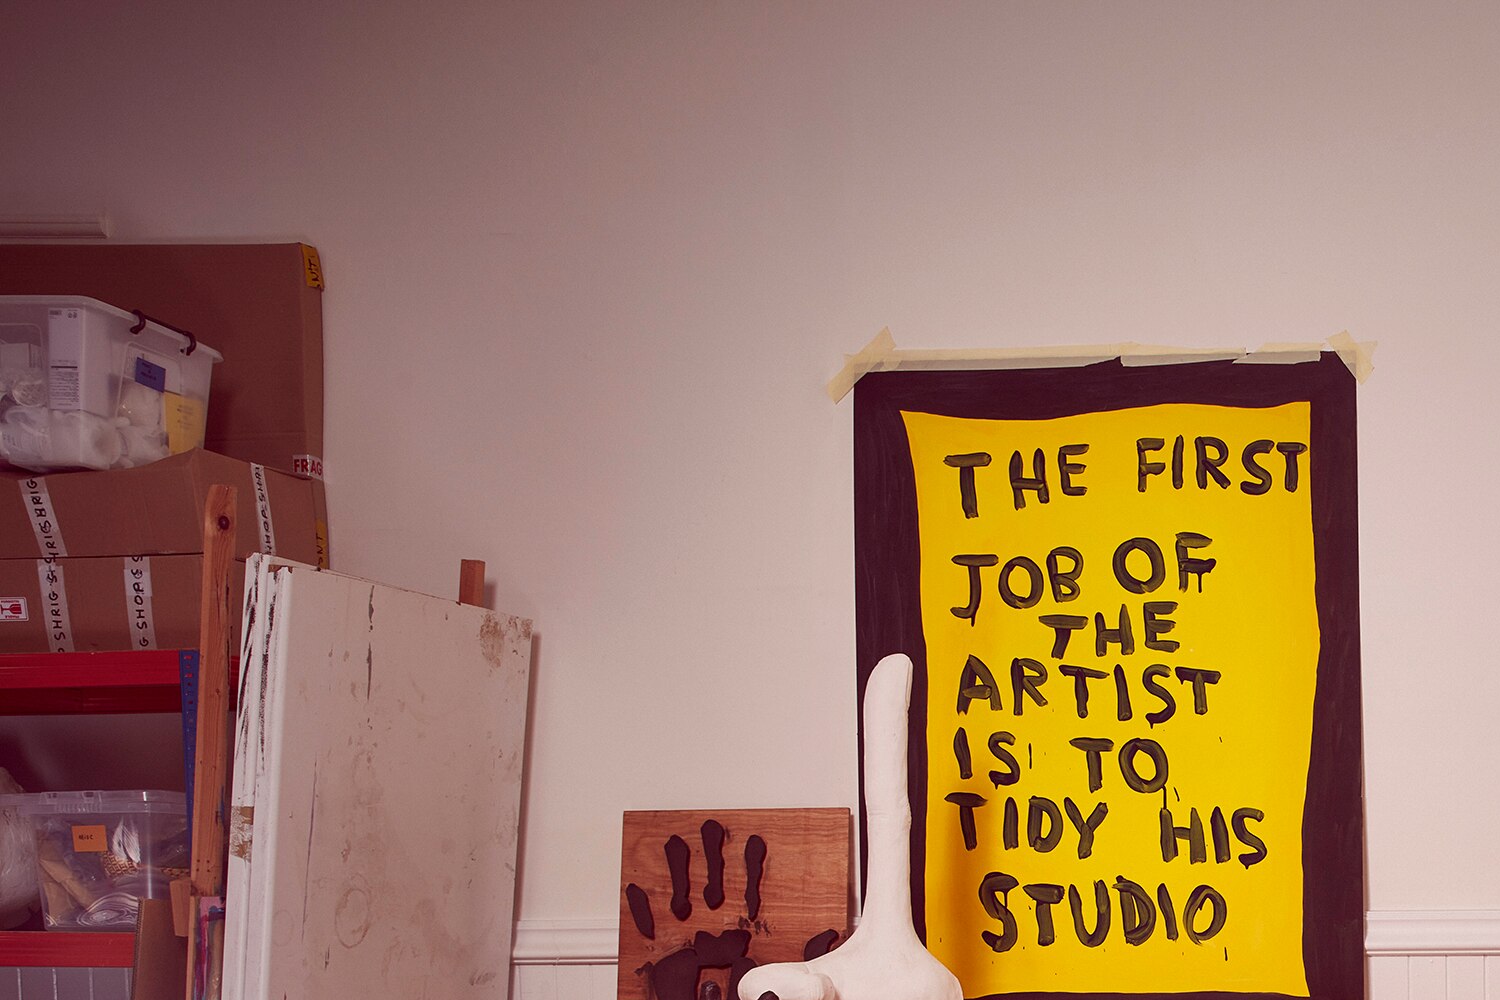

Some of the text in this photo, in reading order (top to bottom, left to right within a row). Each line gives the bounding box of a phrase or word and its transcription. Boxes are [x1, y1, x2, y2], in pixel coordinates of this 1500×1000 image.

[942, 434, 1309, 519] THE FIRST
[949, 532, 1217, 624] JOB OF
[1038, 601, 1180, 660] THE
[956, 654, 1222, 728] ARTIST
[952, 727, 1170, 794] IS TO
[943, 791, 1270, 870] TIDY HIS
[978, 871, 1228, 953] STUDIO
